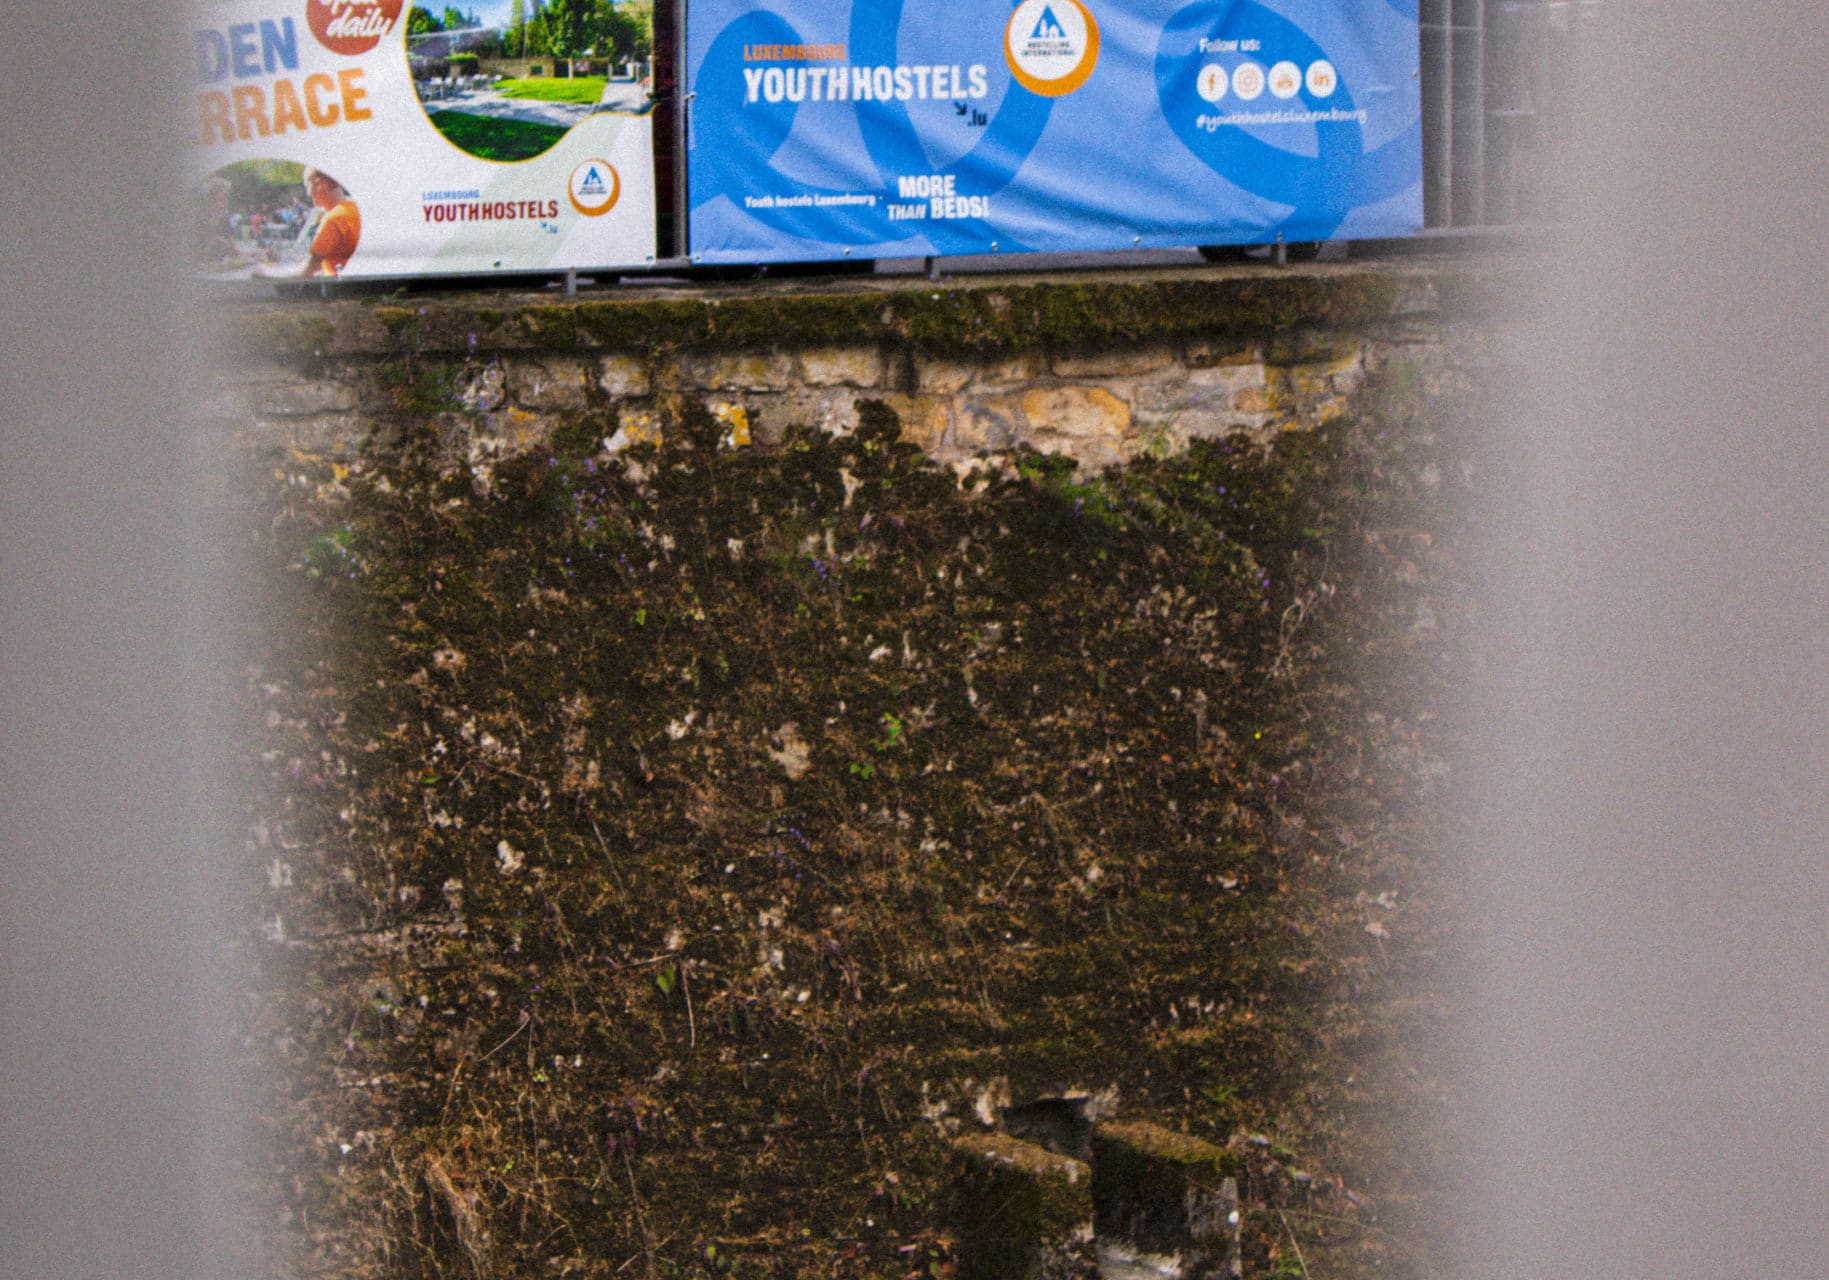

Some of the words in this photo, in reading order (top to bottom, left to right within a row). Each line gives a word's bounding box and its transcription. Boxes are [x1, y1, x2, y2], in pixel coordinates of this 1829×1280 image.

[326, 6, 392, 38] daily
[743, 43, 848, 61] LUXEMBOURG
[1199, 37, 1239, 53] Follow
[199, 68, 373, 146] RRACE
[898, 174, 956, 198] MORE
[745, 194, 774, 209] Youth
[887, 204, 927, 221] THAN
[930, 195, 990, 220] BEDS!
